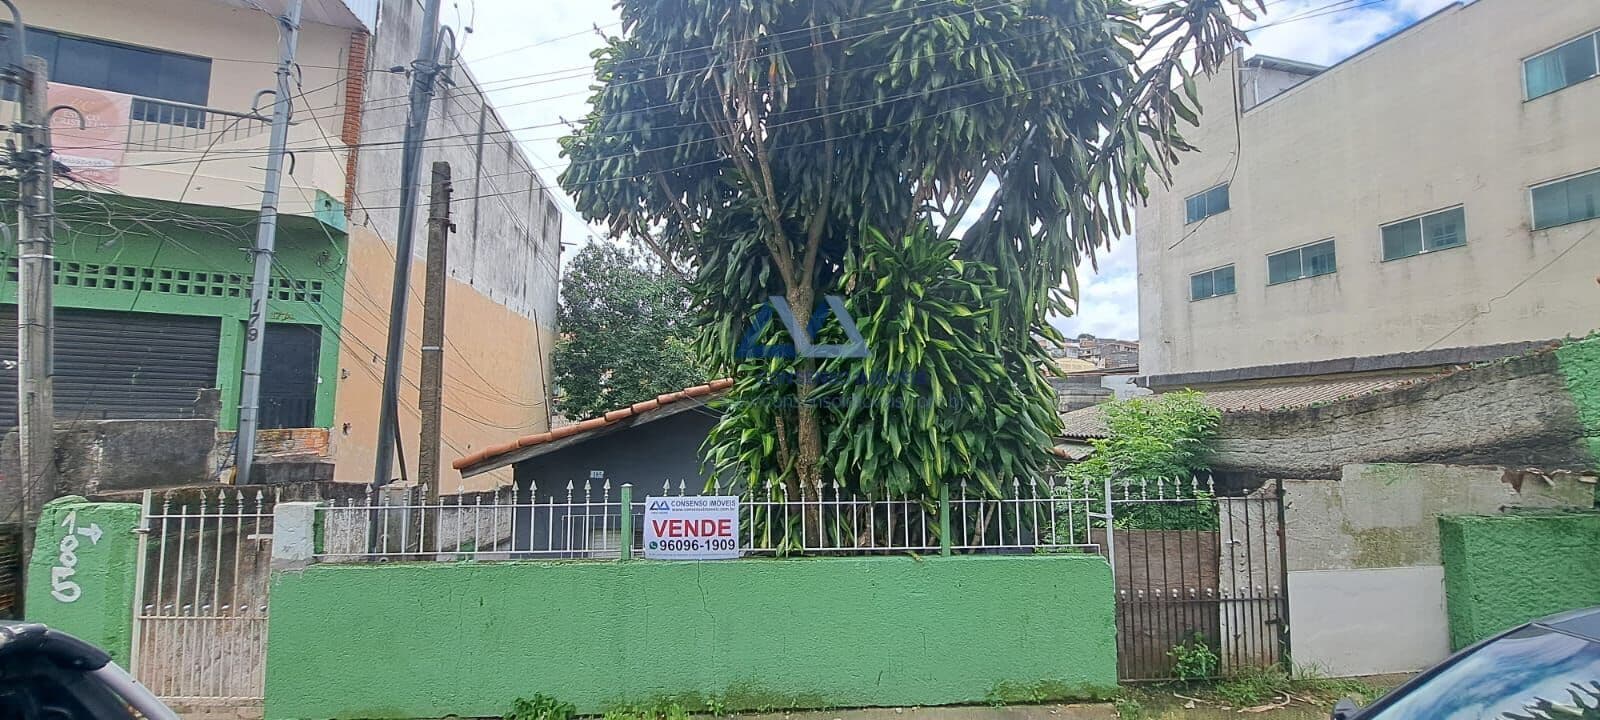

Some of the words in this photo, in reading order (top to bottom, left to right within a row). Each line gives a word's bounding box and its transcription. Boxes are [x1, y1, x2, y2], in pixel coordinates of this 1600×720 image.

[248, 299, 260, 342] 179
[652, 519, 732, 538] VENDE
[660, 539, 735, 551] 96096-1909
